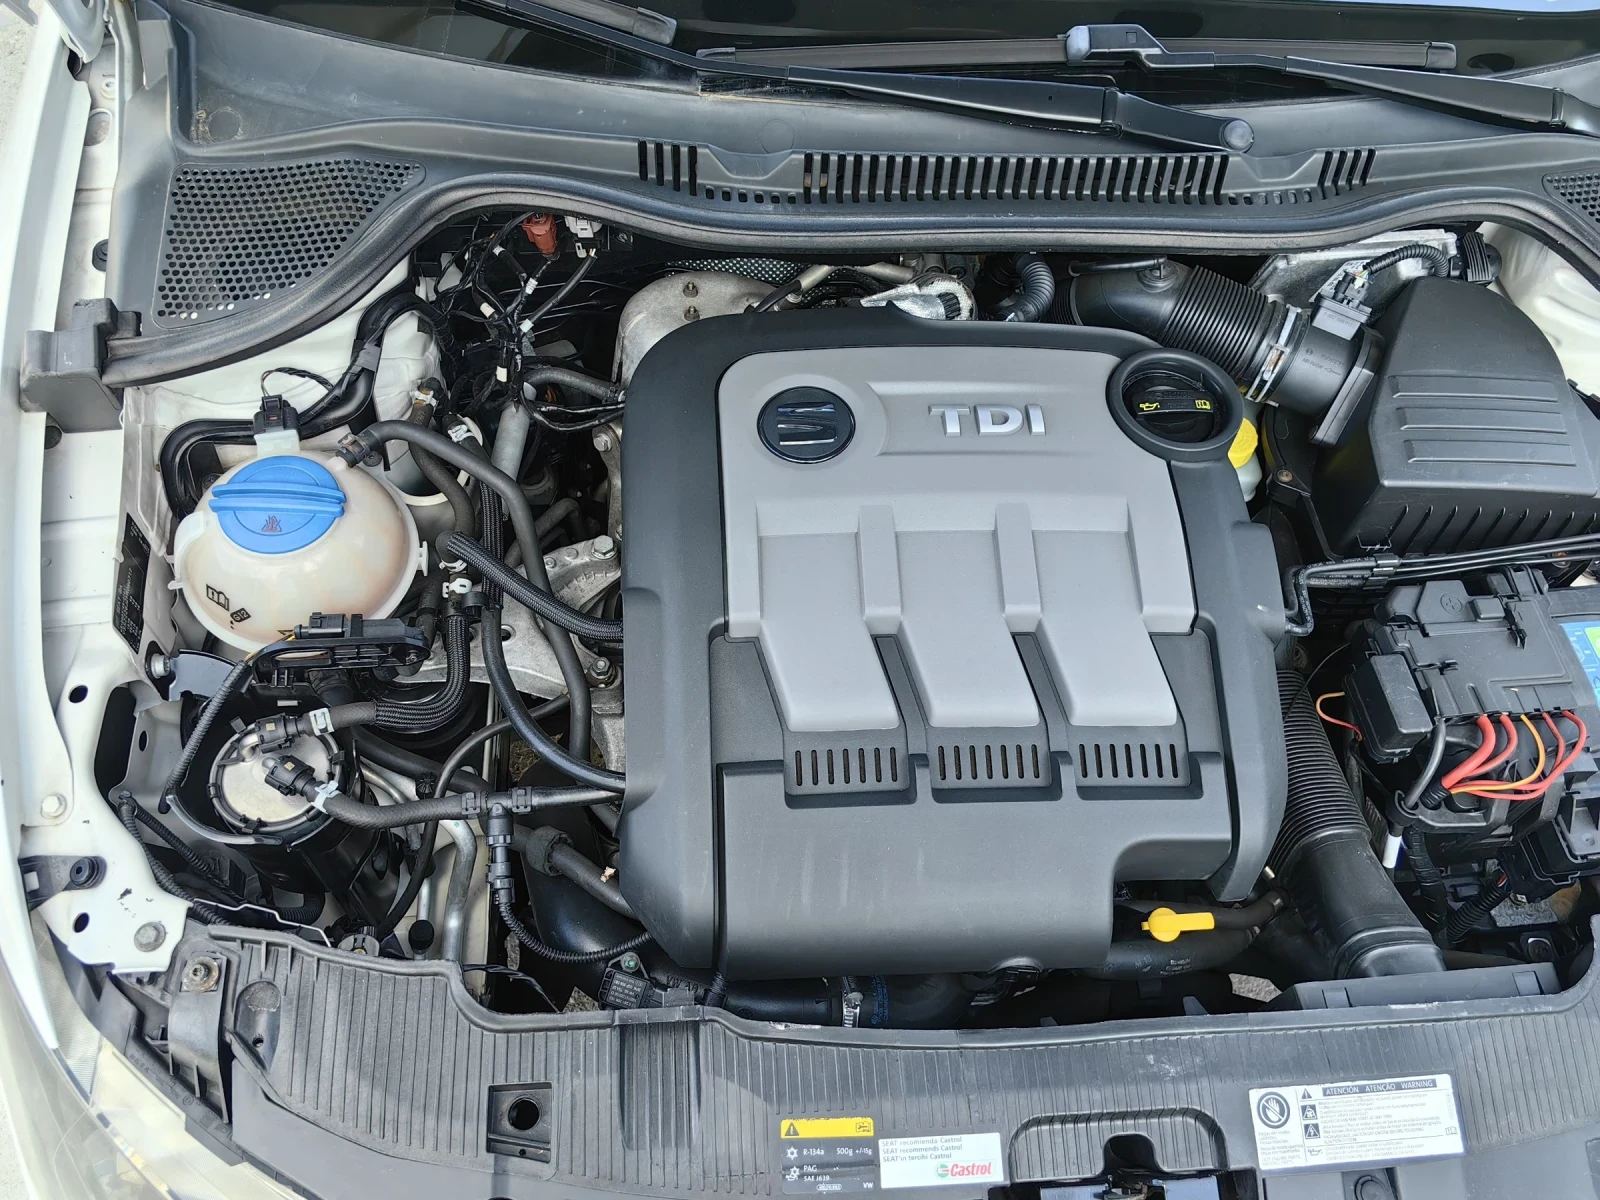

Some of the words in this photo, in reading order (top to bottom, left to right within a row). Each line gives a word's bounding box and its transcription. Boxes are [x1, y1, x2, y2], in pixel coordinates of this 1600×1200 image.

[928, 403, 1046, 437] TDI
[232, 610, 249, 621] G12
[1325, 1085, 1360, 1096] ATENCIÓN
[1365, 1081, 1396, 1093] ATENÇÃO
[1400, 1079, 1433, 1090] WARNING
[881, 1139, 898, 1147] SEAT
[899, 1138, 938, 1146] recomienda
[939, 1136, 963, 1144] Castrol
[803, 1148, 825, 1156] R-134a
[836, 1147, 854, 1156] 500g
[882, 1147, 898, 1155] SEAT
[899, 1145, 940, 1154] recommends
[940, 1144, 963, 1152] Castrol
[908, 1153, 929, 1161] tercihi
[929, 1152, 952, 1160] Castrol
[803, 1164, 818, 1173] PAG
[950, 1161, 993, 1177] Castrol
[862, 1181, 874, 1189] VW
